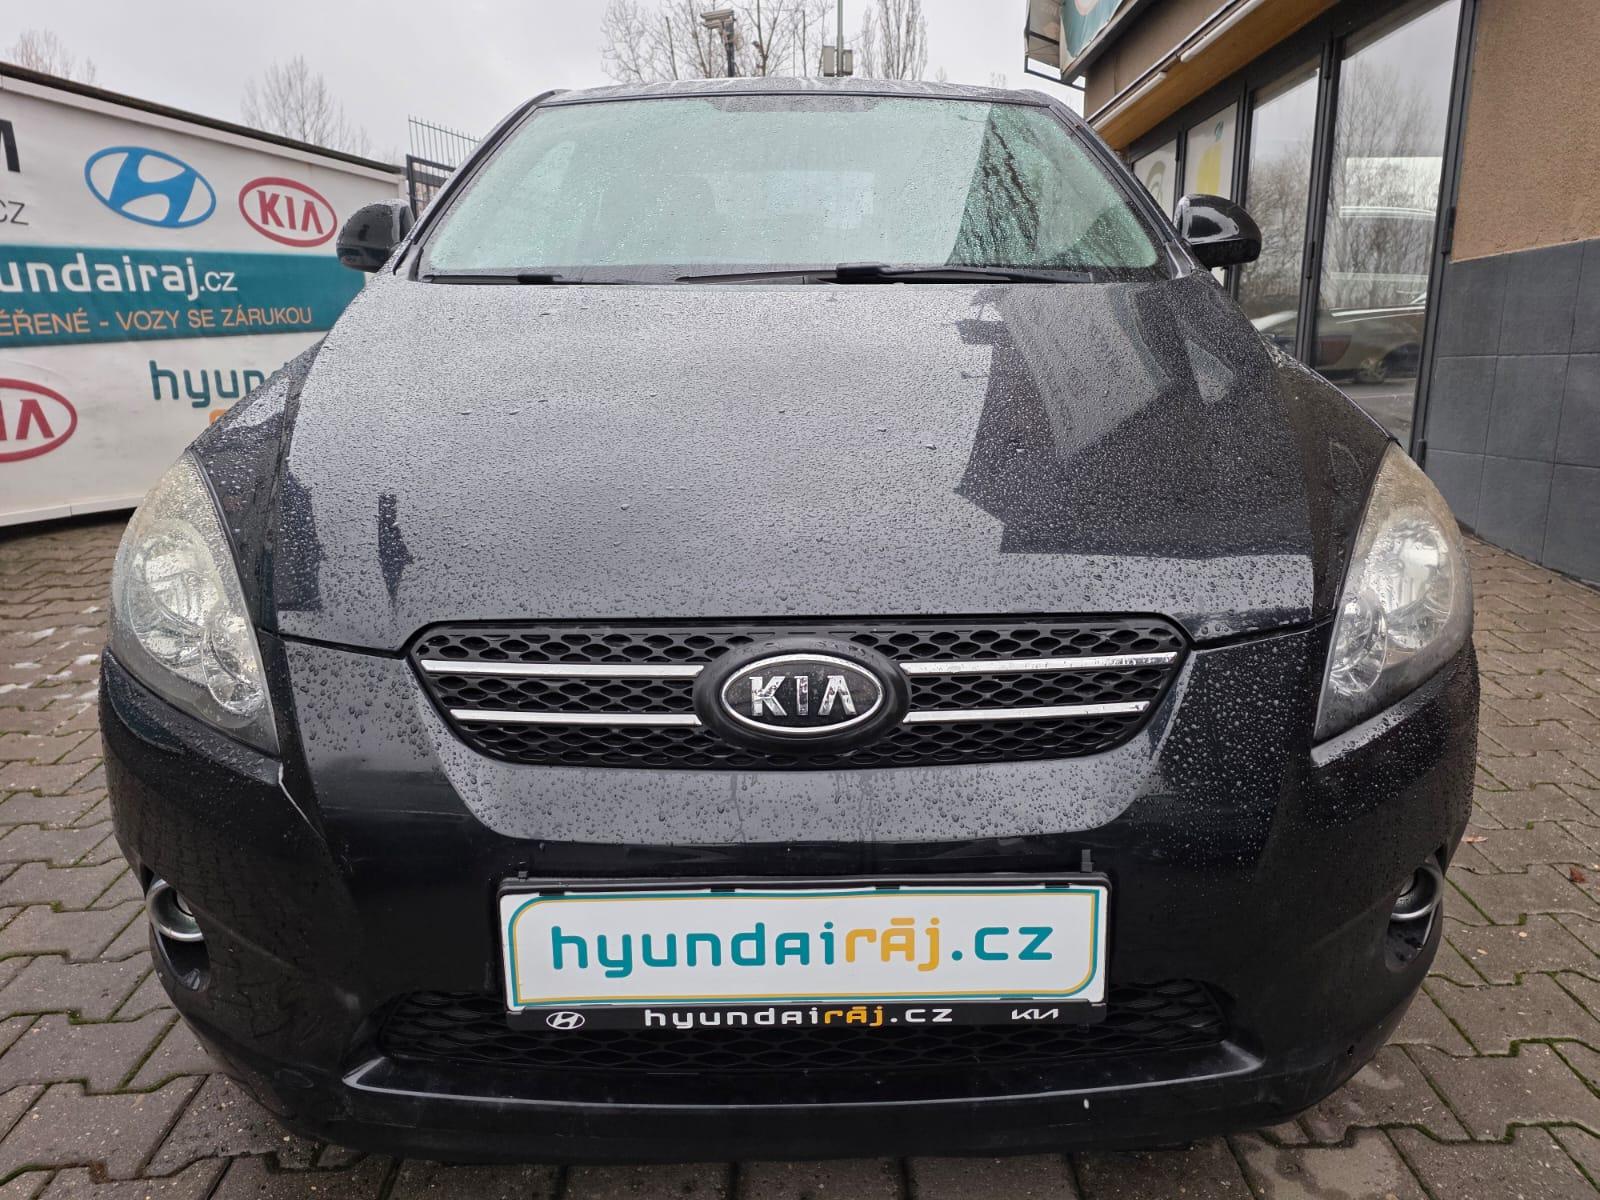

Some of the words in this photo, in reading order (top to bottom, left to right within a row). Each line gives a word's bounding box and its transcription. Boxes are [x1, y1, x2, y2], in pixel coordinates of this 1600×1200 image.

[256, 190, 324, 235] KIA
[115, 310, 180, 331] VOZY
[188, 307, 216, 328] SE
[221, 304, 312, 327] ZÁRUKOU
[149, 360, 280, 408] hyun
[749, 675, 857, 717] KIA
[1011, 1008, 1059, 1020] KIA
